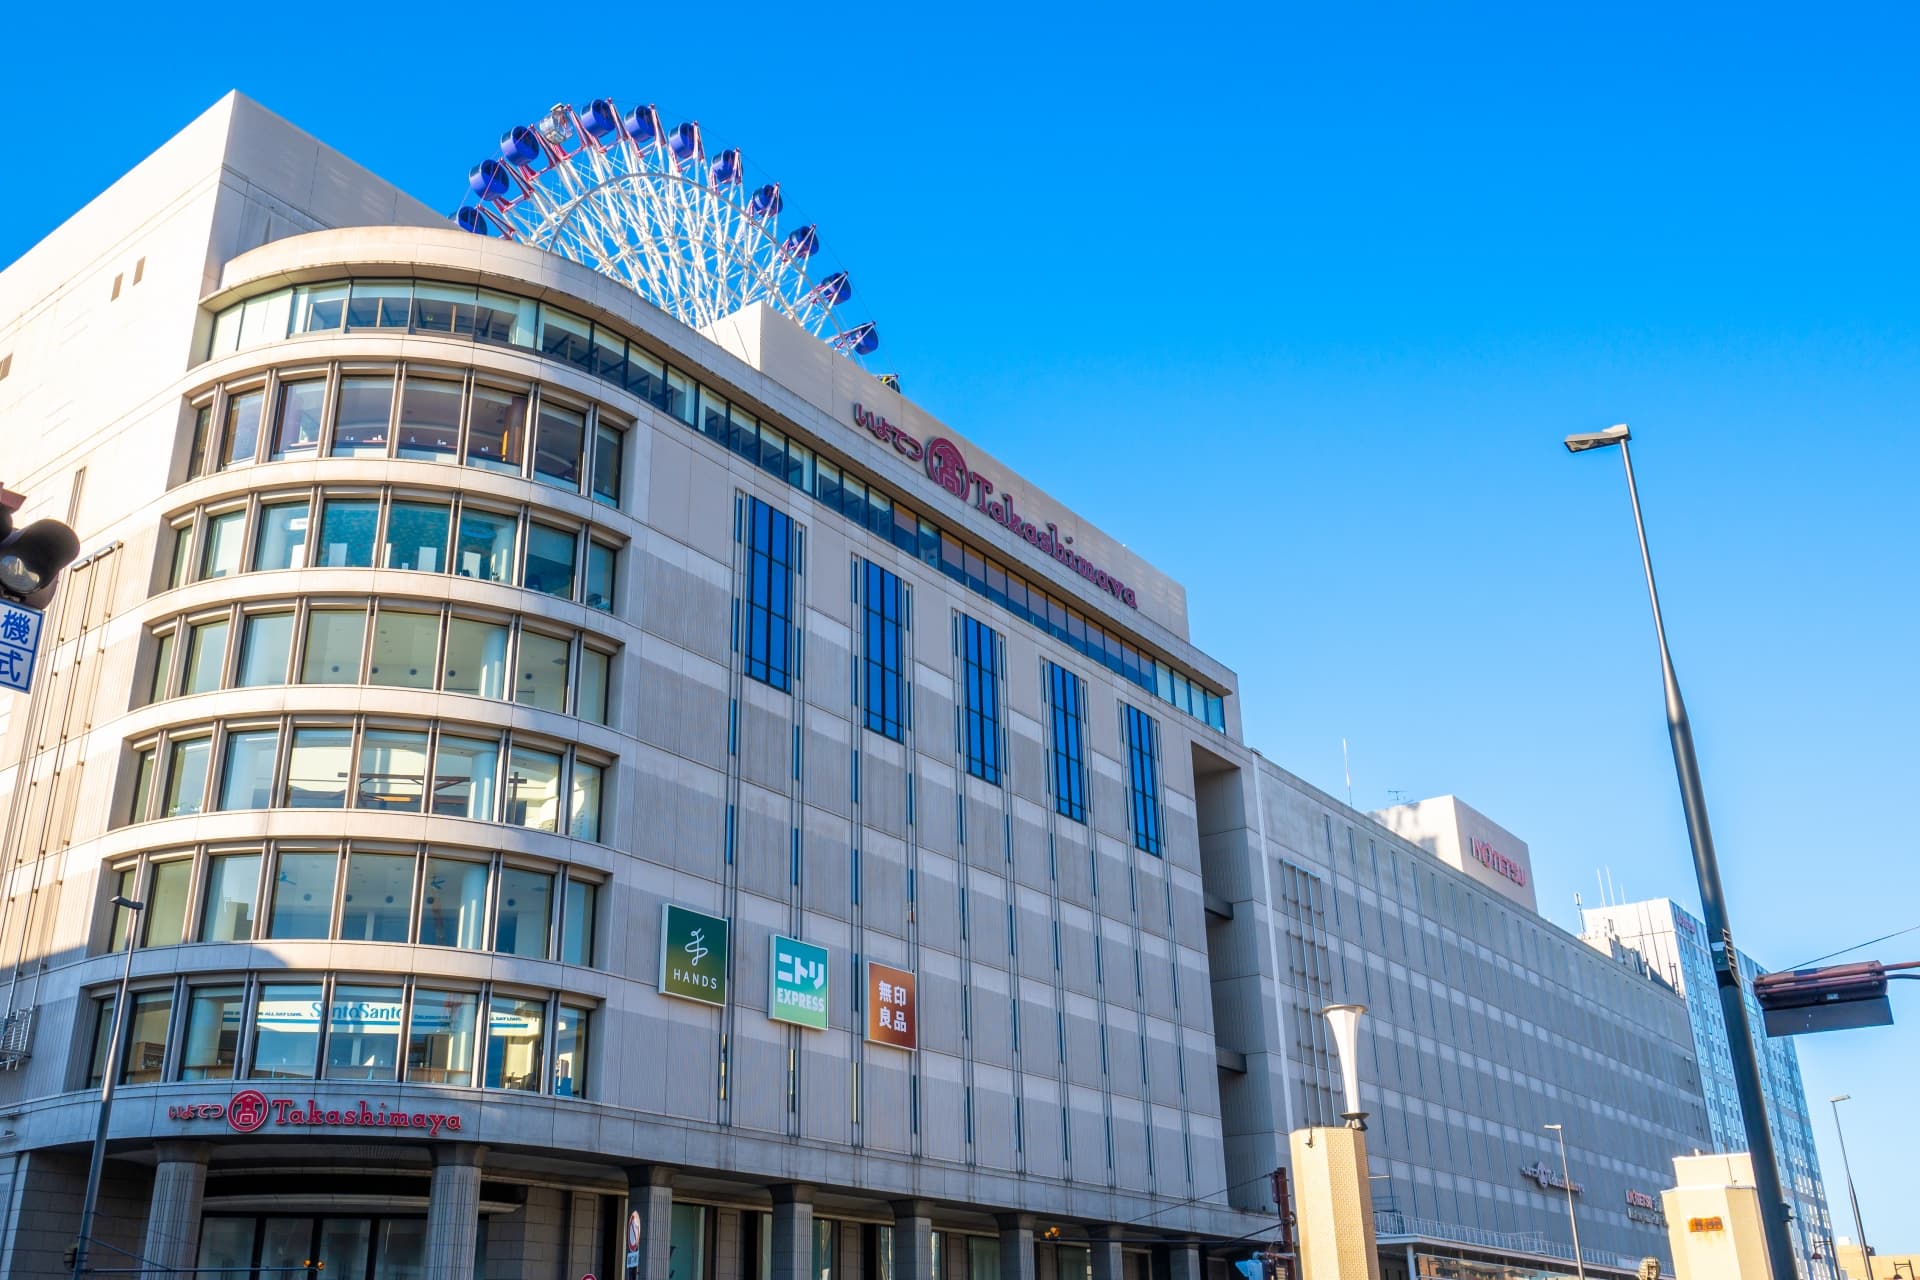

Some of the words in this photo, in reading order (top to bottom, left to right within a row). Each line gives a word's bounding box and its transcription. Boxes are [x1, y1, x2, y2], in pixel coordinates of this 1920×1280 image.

[855, 403, 923, 461] いよてつ
[969, 471, 1137, 608] Takashimaya
[1, 610, 31, 645] 機
[673, 968, 718, 990] HANDS
[777, 952, 825, 990] ニトリ
[312, 1002, 402, 1020] SntoSanto
[776, 987, 825, 1013] EXPRESS
[168, 1104, 224, 1120] いよてつ
[271, 1099, 462, 1136] Takashimaya
